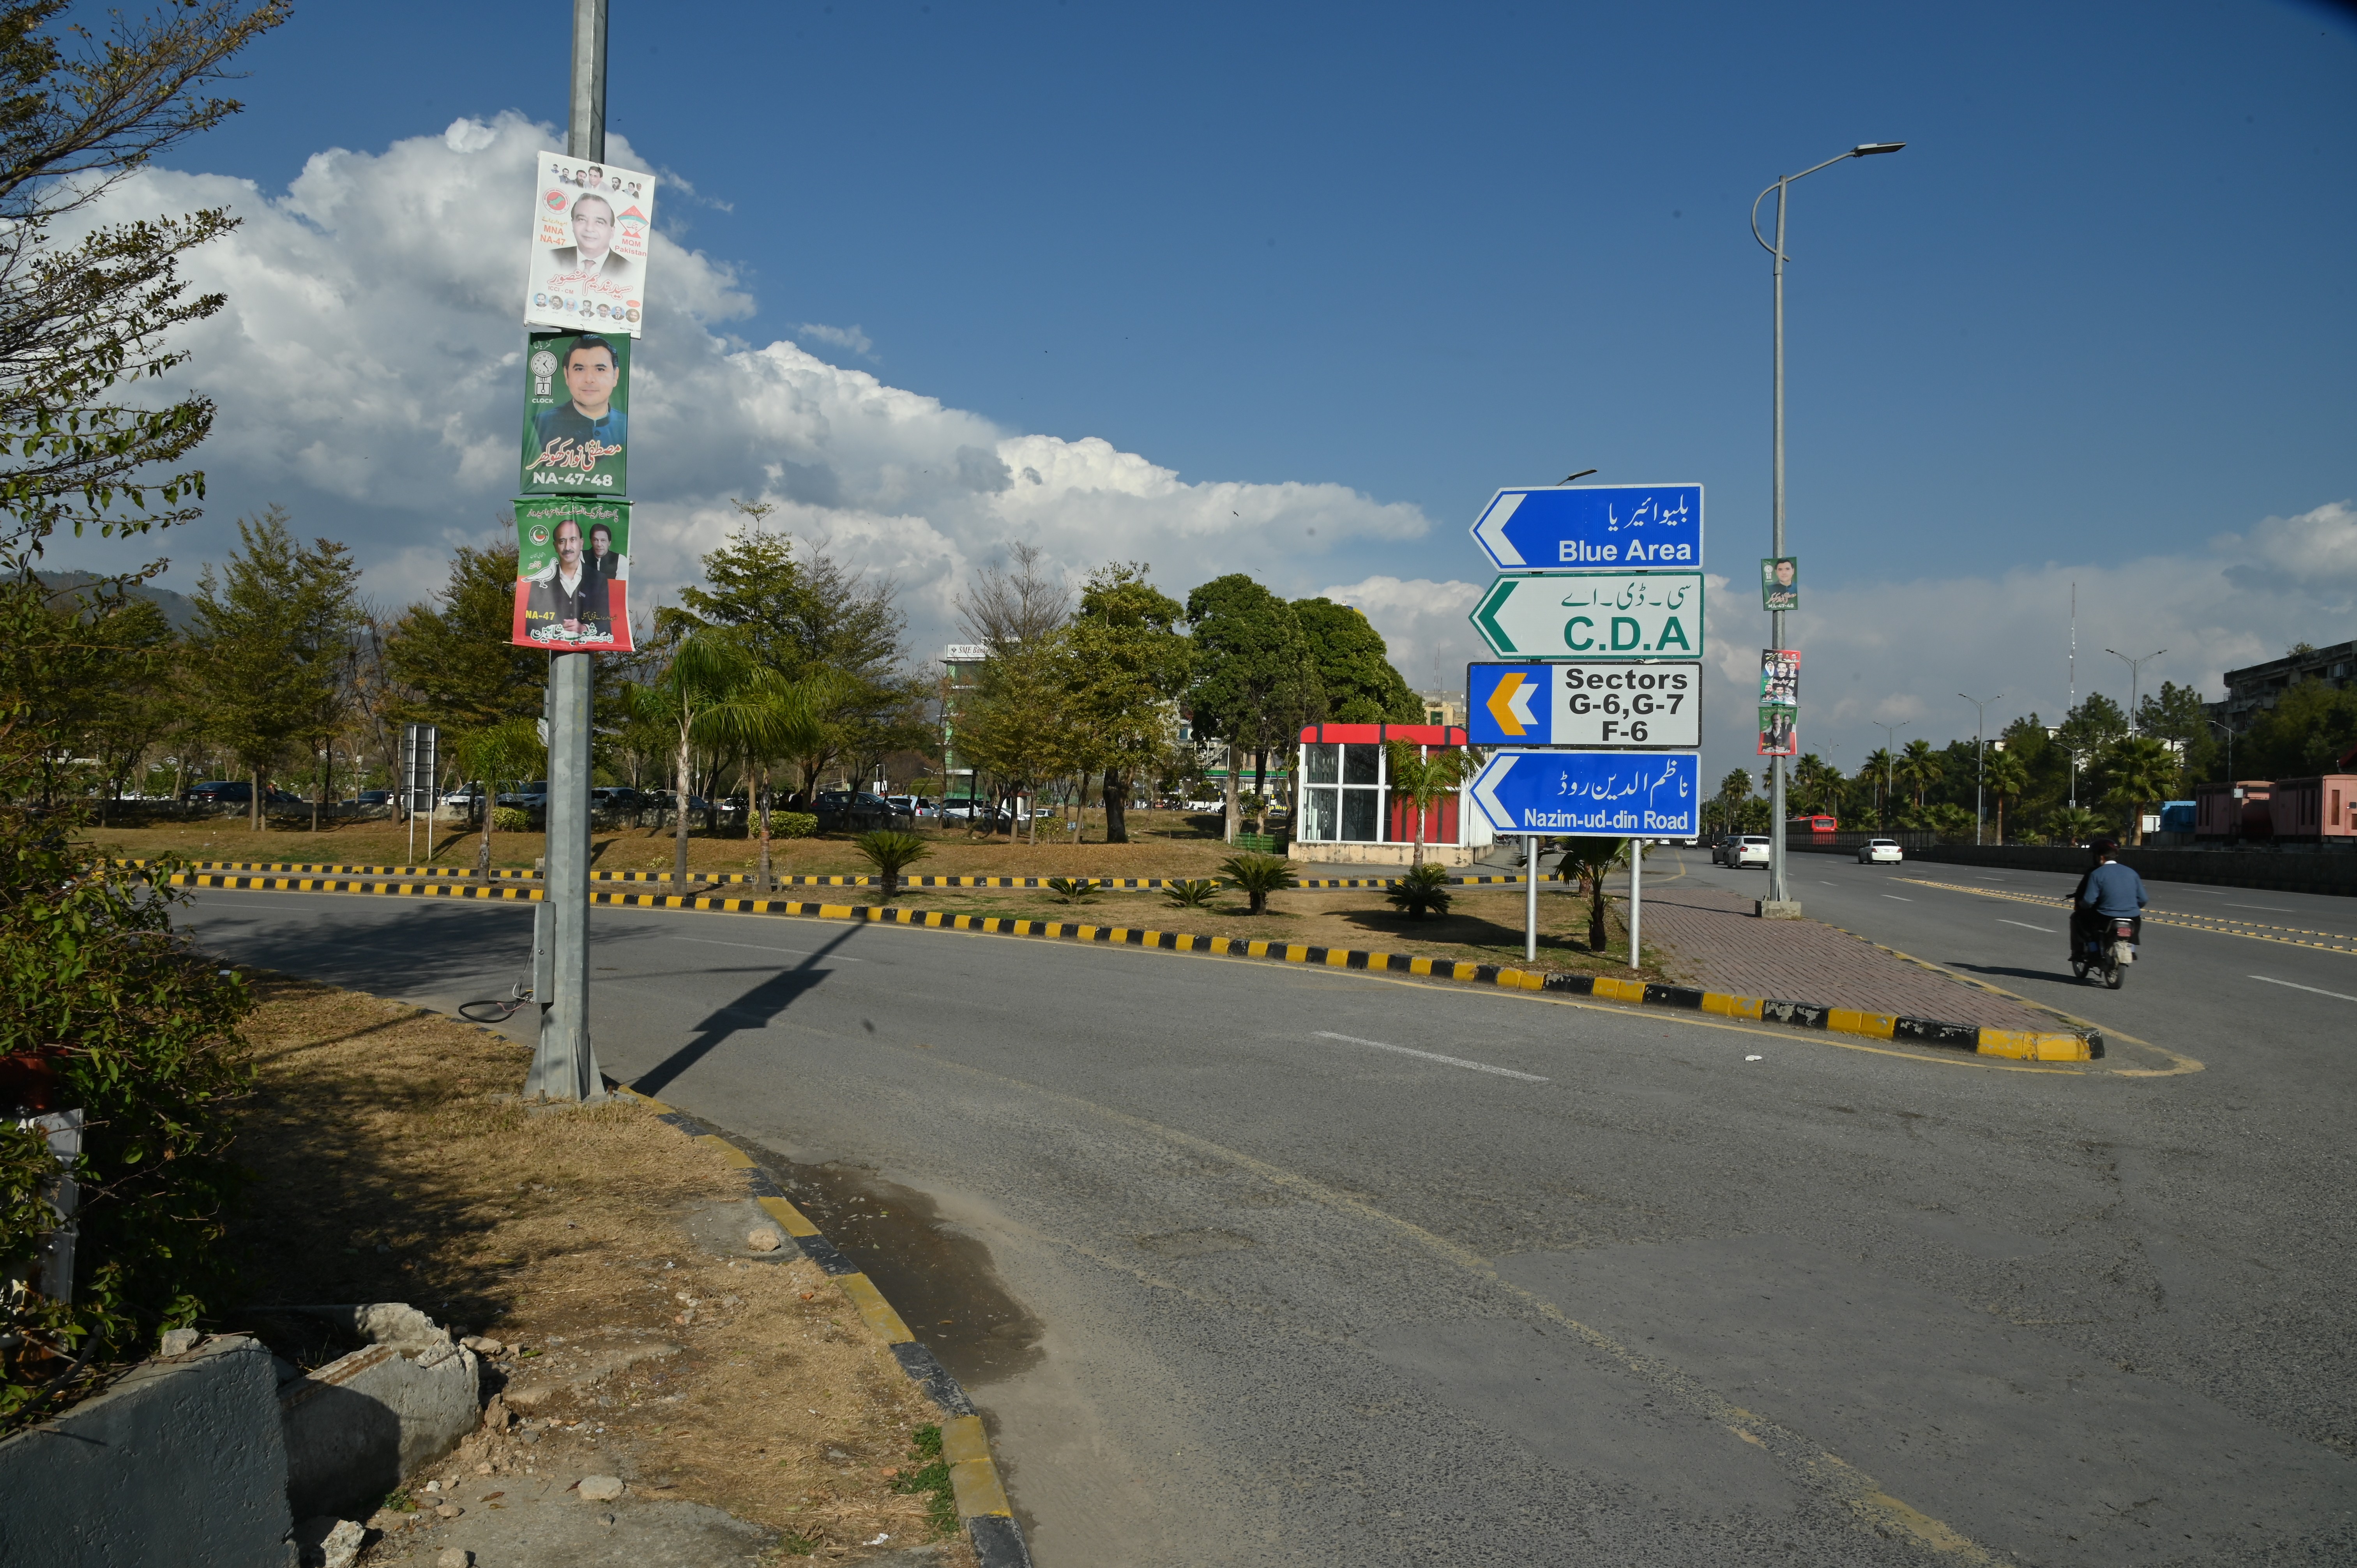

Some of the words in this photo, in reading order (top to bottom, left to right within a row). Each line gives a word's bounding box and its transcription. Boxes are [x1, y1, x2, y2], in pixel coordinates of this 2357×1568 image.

[544, 224, 564, 235] MNA
[540, 234, 565, 245] NA-47
[622, 238, 641, 247] MQM
[615, 245, 647, 257] Pakistan
[547, 269, 588, 286] منصور
[582, 273, 612, 296] ندیم
[606, 284, 633, 300] سید
[560, 444, 584, 467] نواز
[533, 472, 613, 487] NA-47-48
[584, 506, 603, 519] تحریک
[599, 509, 619, 523] پاکستان
[1560, 540, 1617, 561] Blue
[1626, 539, 1691, 560] Area
[525, 610, 555, 621] NA-47
[1564, 616, 1691, 651] C.D.A
[1565, 668, 1687, 689] Sectors
[1602, 721, 1648, 742] F-6
[1557, 771, 1589, 795] روڈ
[1591, 772, 1648, 800] الدین
[1650, 759, 1688, 807] ناظم
[1525, 809, 1638, 828] Nazim-ud-din
[1644, 811, 1688, 830] Road
